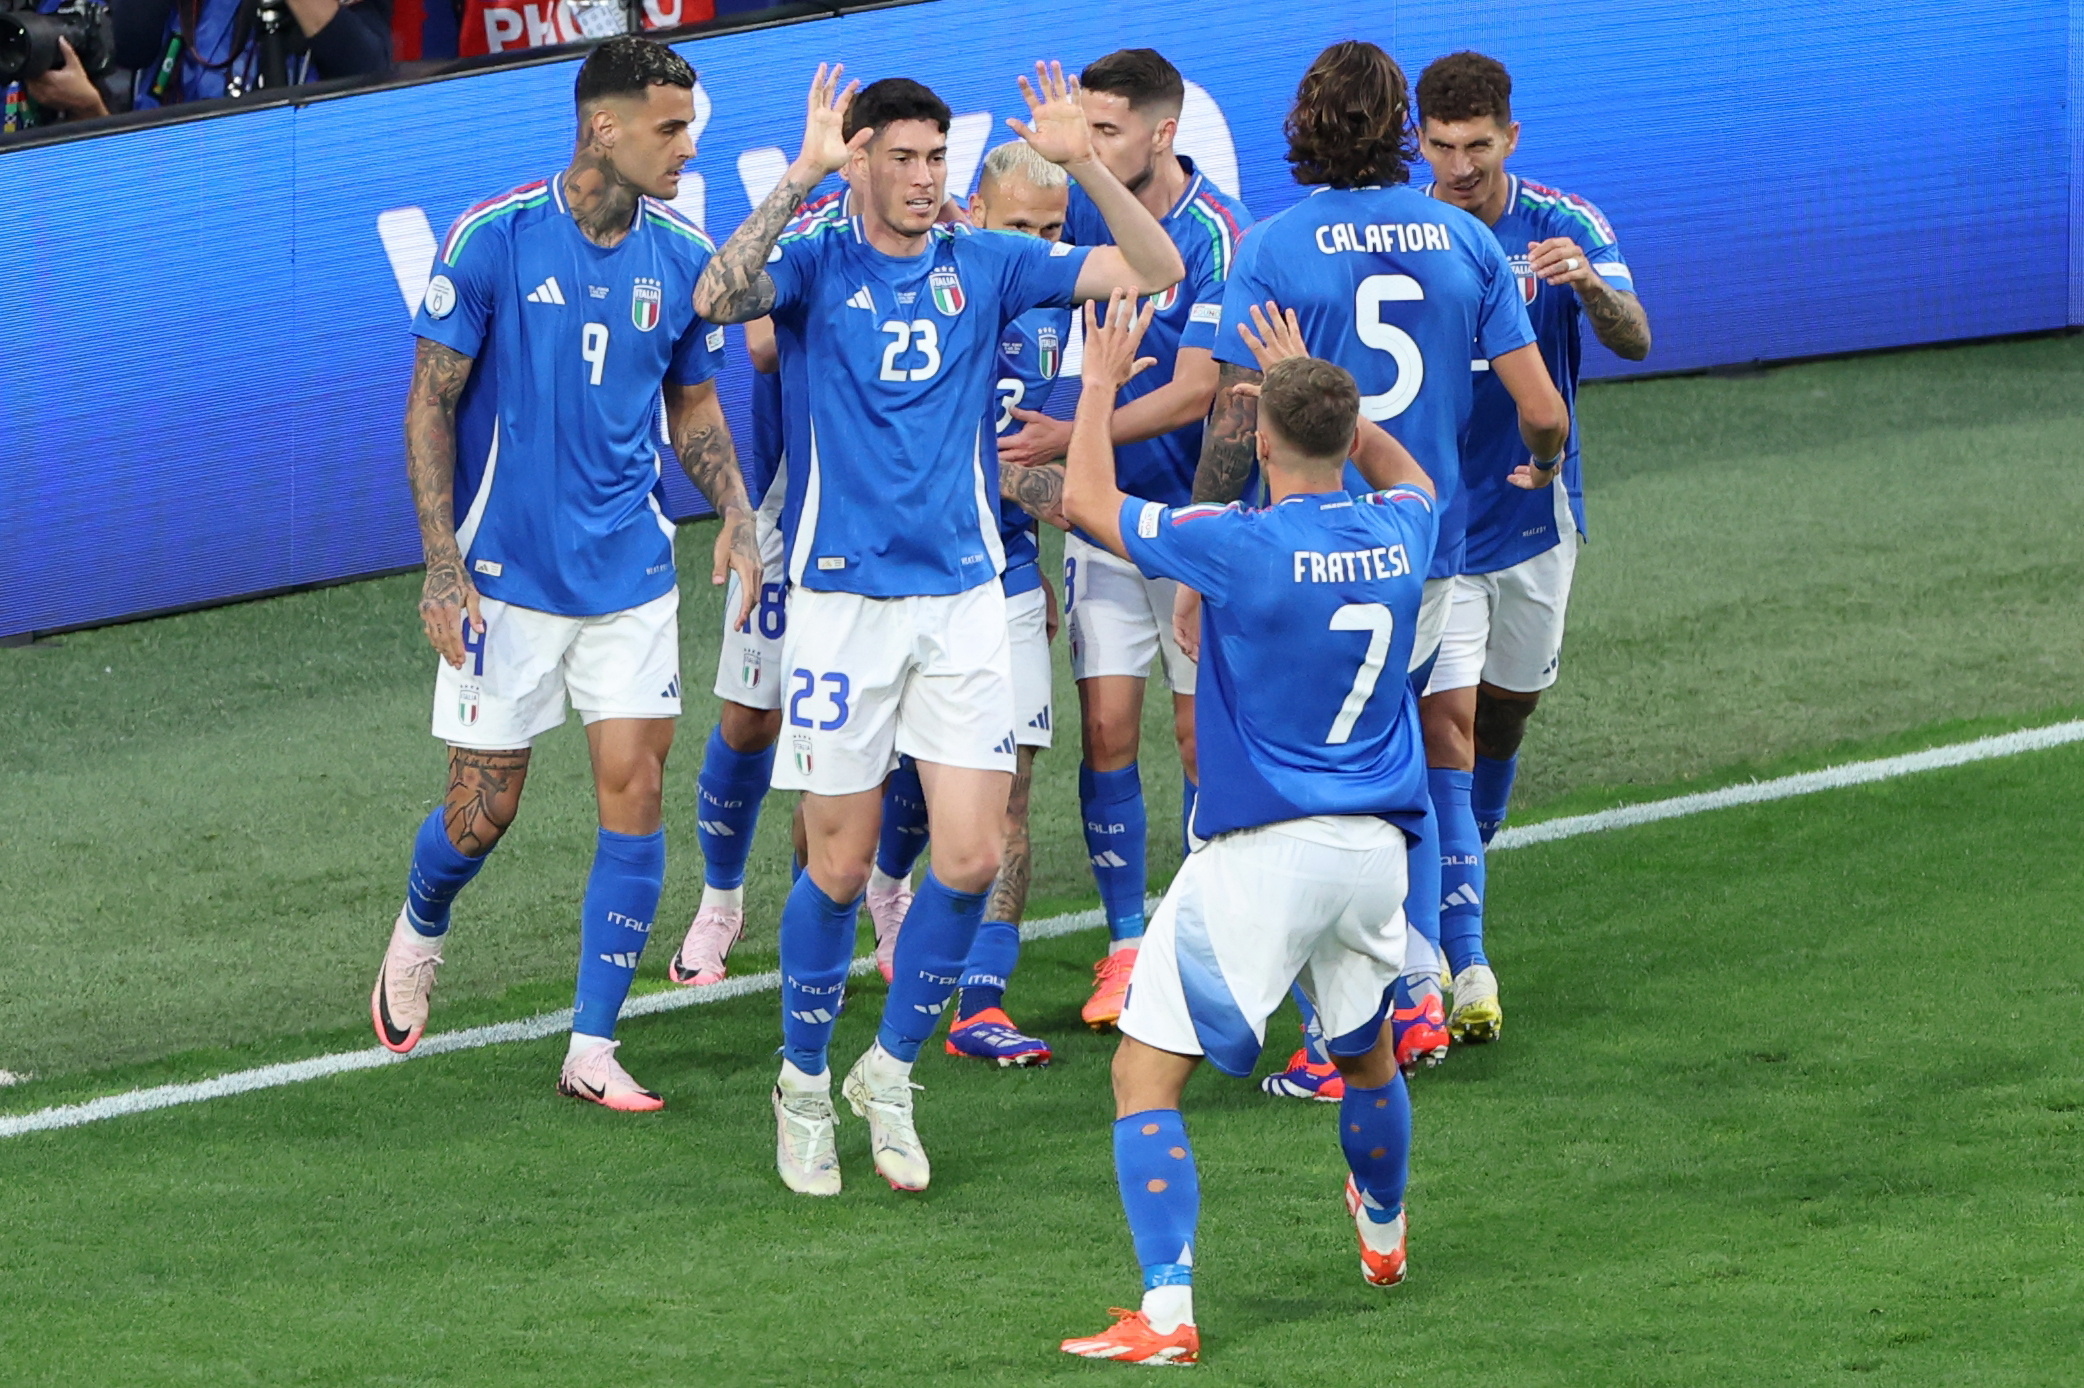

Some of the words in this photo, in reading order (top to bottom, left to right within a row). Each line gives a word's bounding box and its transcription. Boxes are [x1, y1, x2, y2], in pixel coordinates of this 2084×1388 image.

[1315, 222, 1451, 255] CALAFIORI
[635, 289, 659, 300] ITALIA
[932, 275, 956, 287] ITALIA
[582, 322, 609, 386] 9
[880, 318, 941, 382] 23
[1356, 274, 1424, 422] 5
[1294, 543, 1411, 583] FRATTESI
[462, 616, 487, 676] 9
[1325, 603, 1394, 744] 7
[790, 668, 849, 730] 23
[697, 782, 743, 809] TALIA
[1087, 822, 1125, 834] ALIA
[1440, 855, 1479, 867] ALIA
[788, 975, 843, 995] ITALIA
